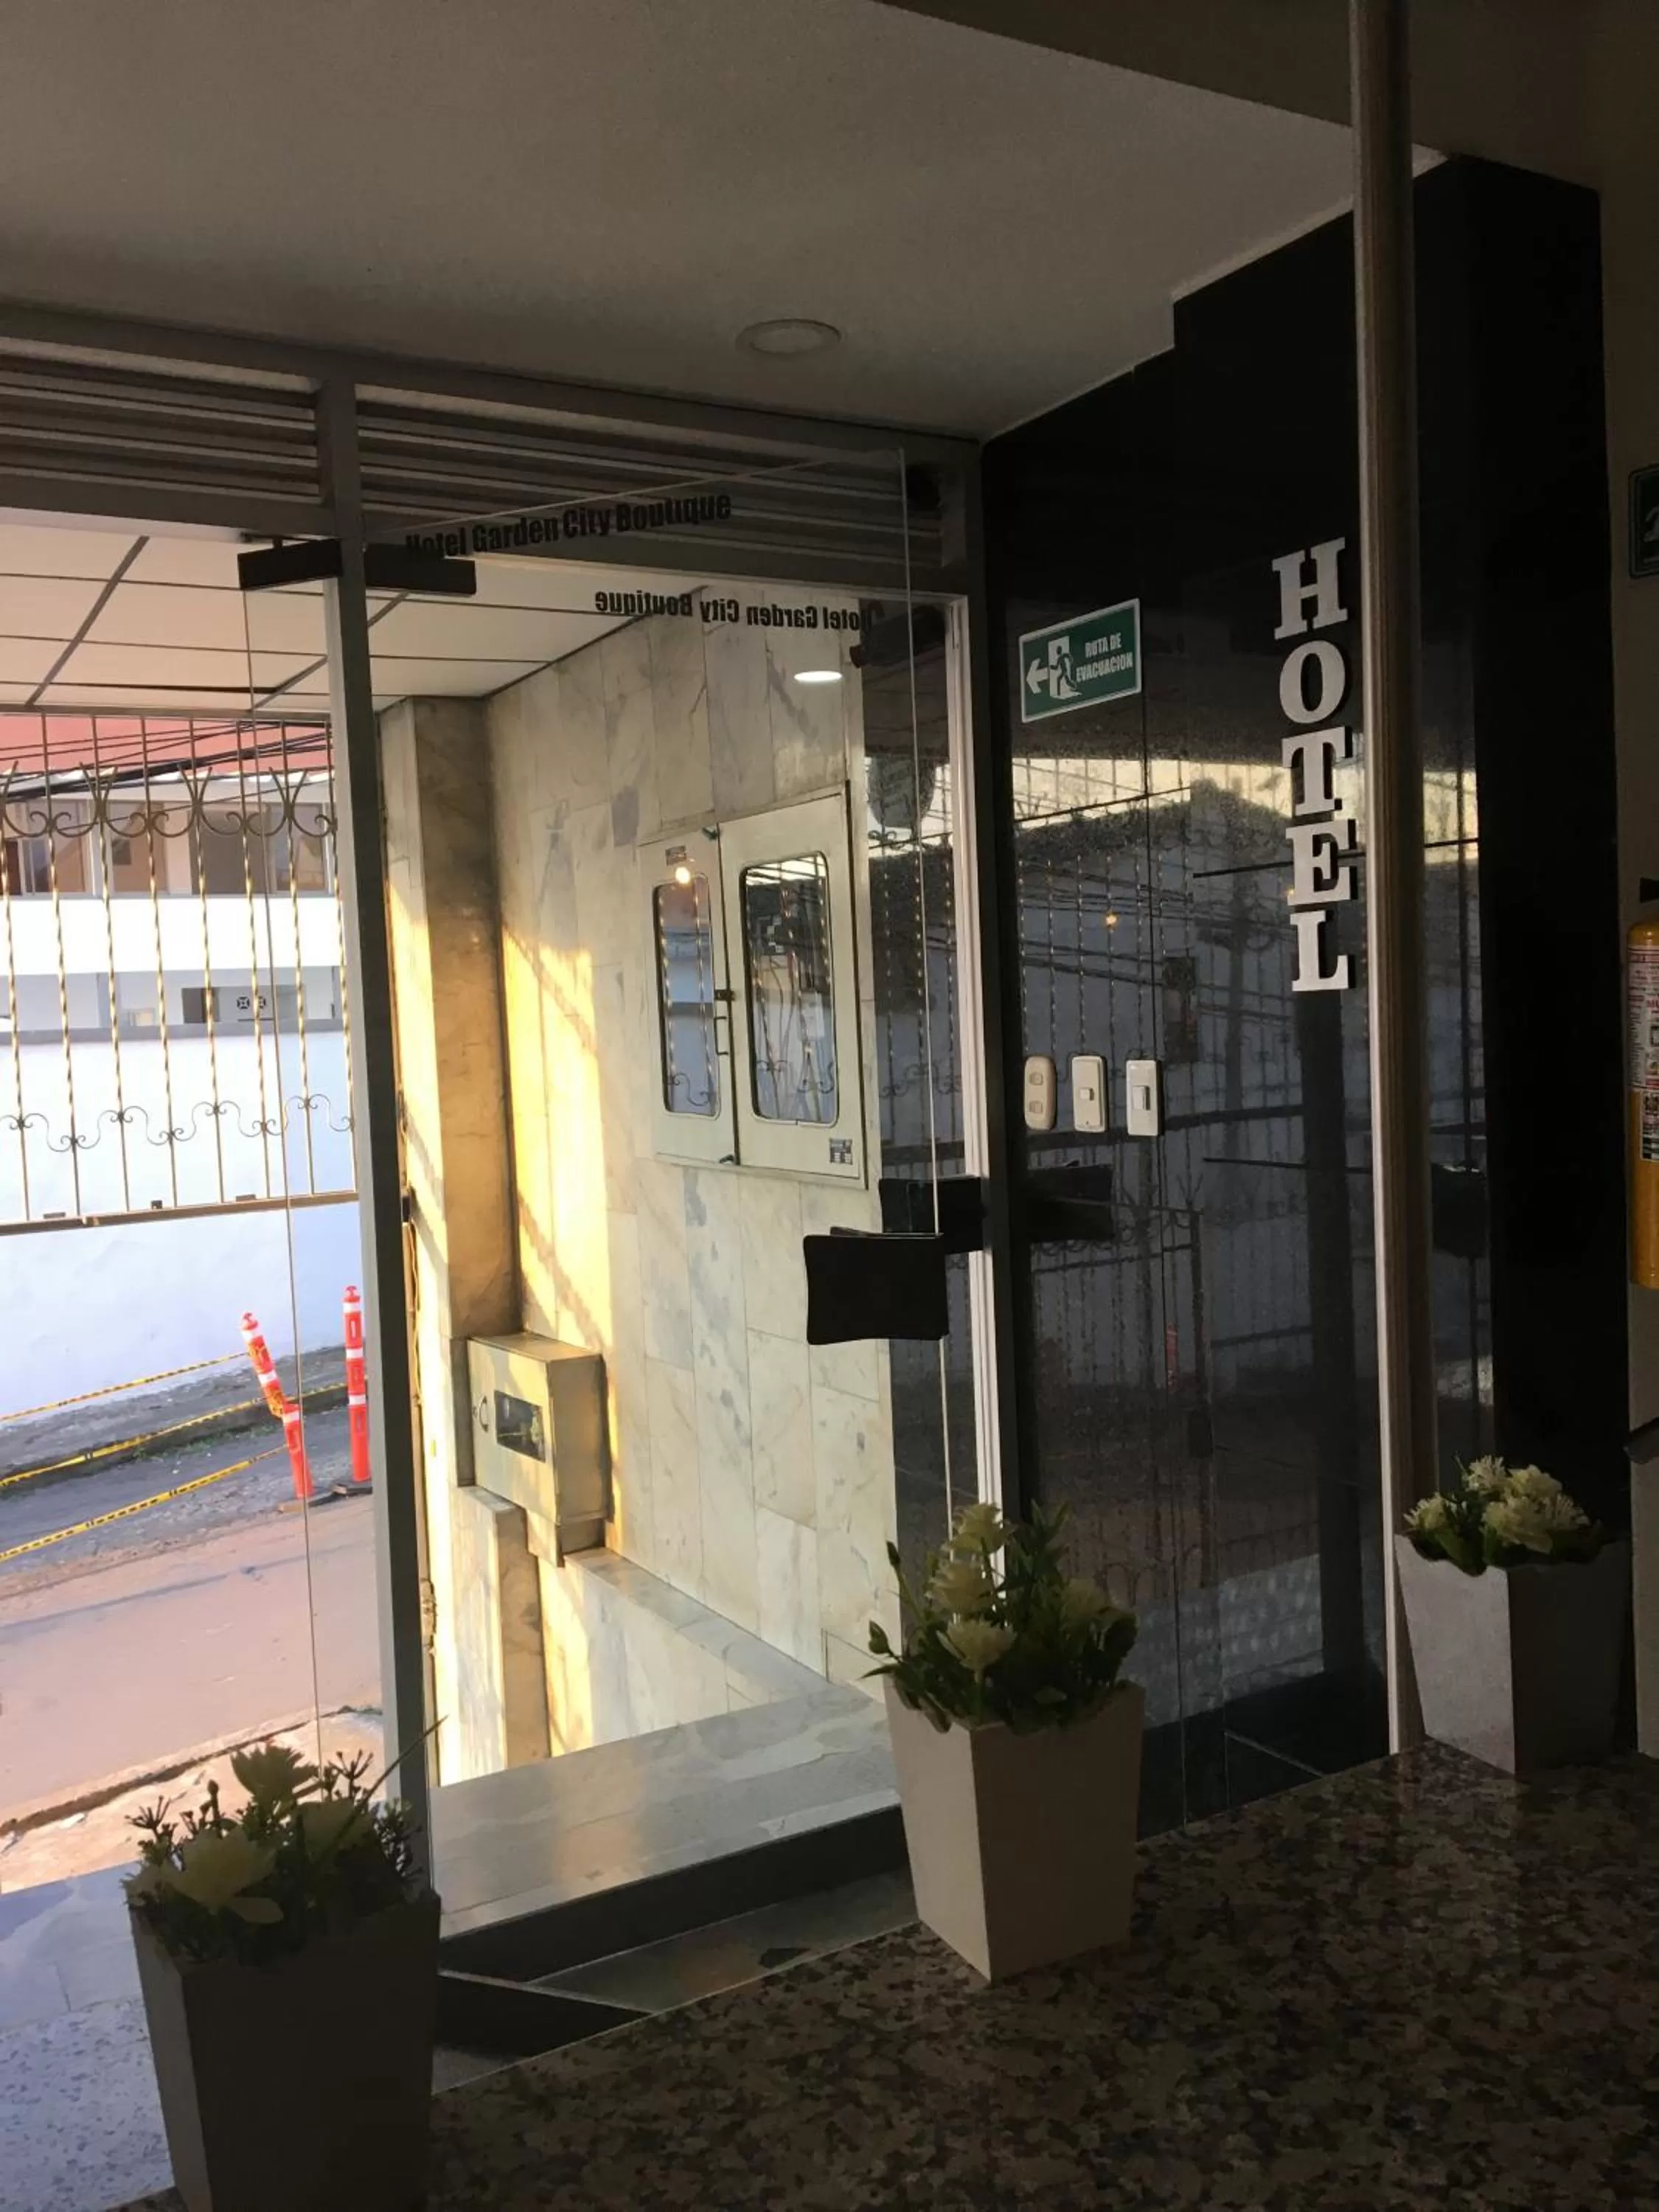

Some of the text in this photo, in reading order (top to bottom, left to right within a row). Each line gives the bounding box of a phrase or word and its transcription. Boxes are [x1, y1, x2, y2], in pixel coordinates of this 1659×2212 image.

[472, 517, 559, 552] Garden
[563, 505, 611, 538] City
[616, 495, 732, 532] Boutique
[1085, 632, 1121, 658] RUTA DE
[1272, 537, 1352, 992] HOTEL
